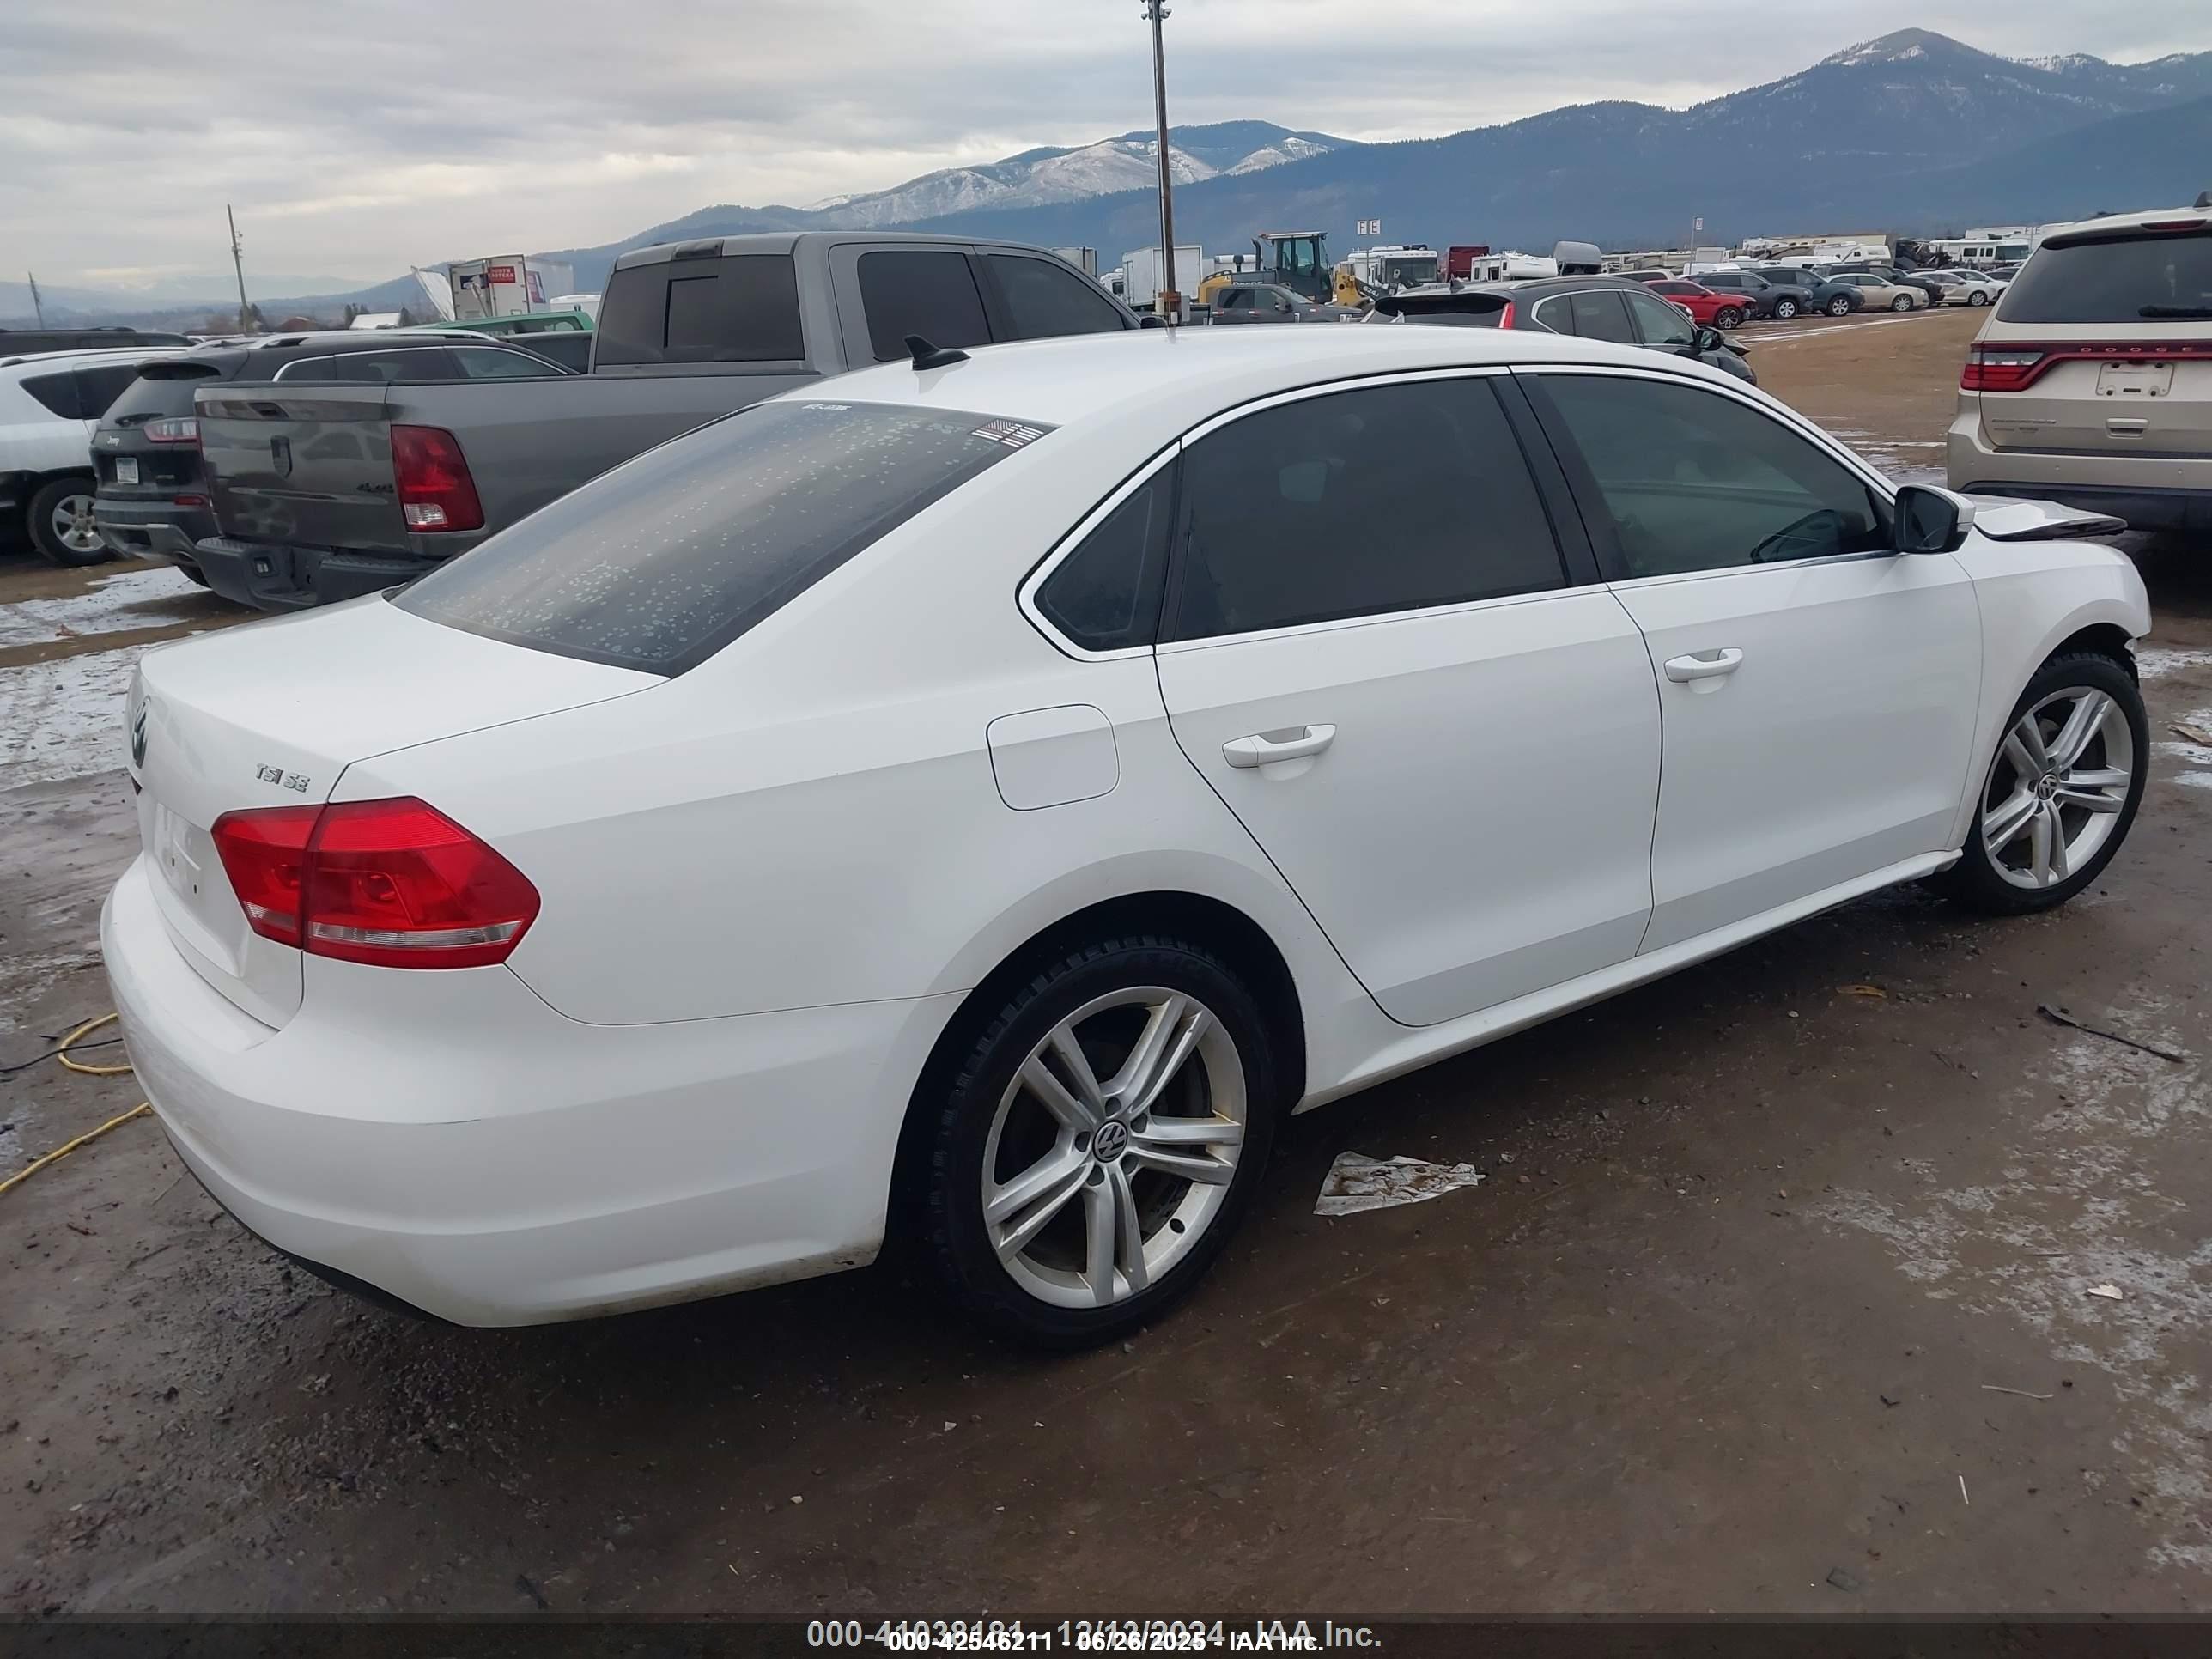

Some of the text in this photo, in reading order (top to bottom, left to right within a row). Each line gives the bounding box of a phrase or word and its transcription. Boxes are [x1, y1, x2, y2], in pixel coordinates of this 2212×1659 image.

[1359, 221, 1378, 234] F E
[256, 763, 311, 793] TSI SE
